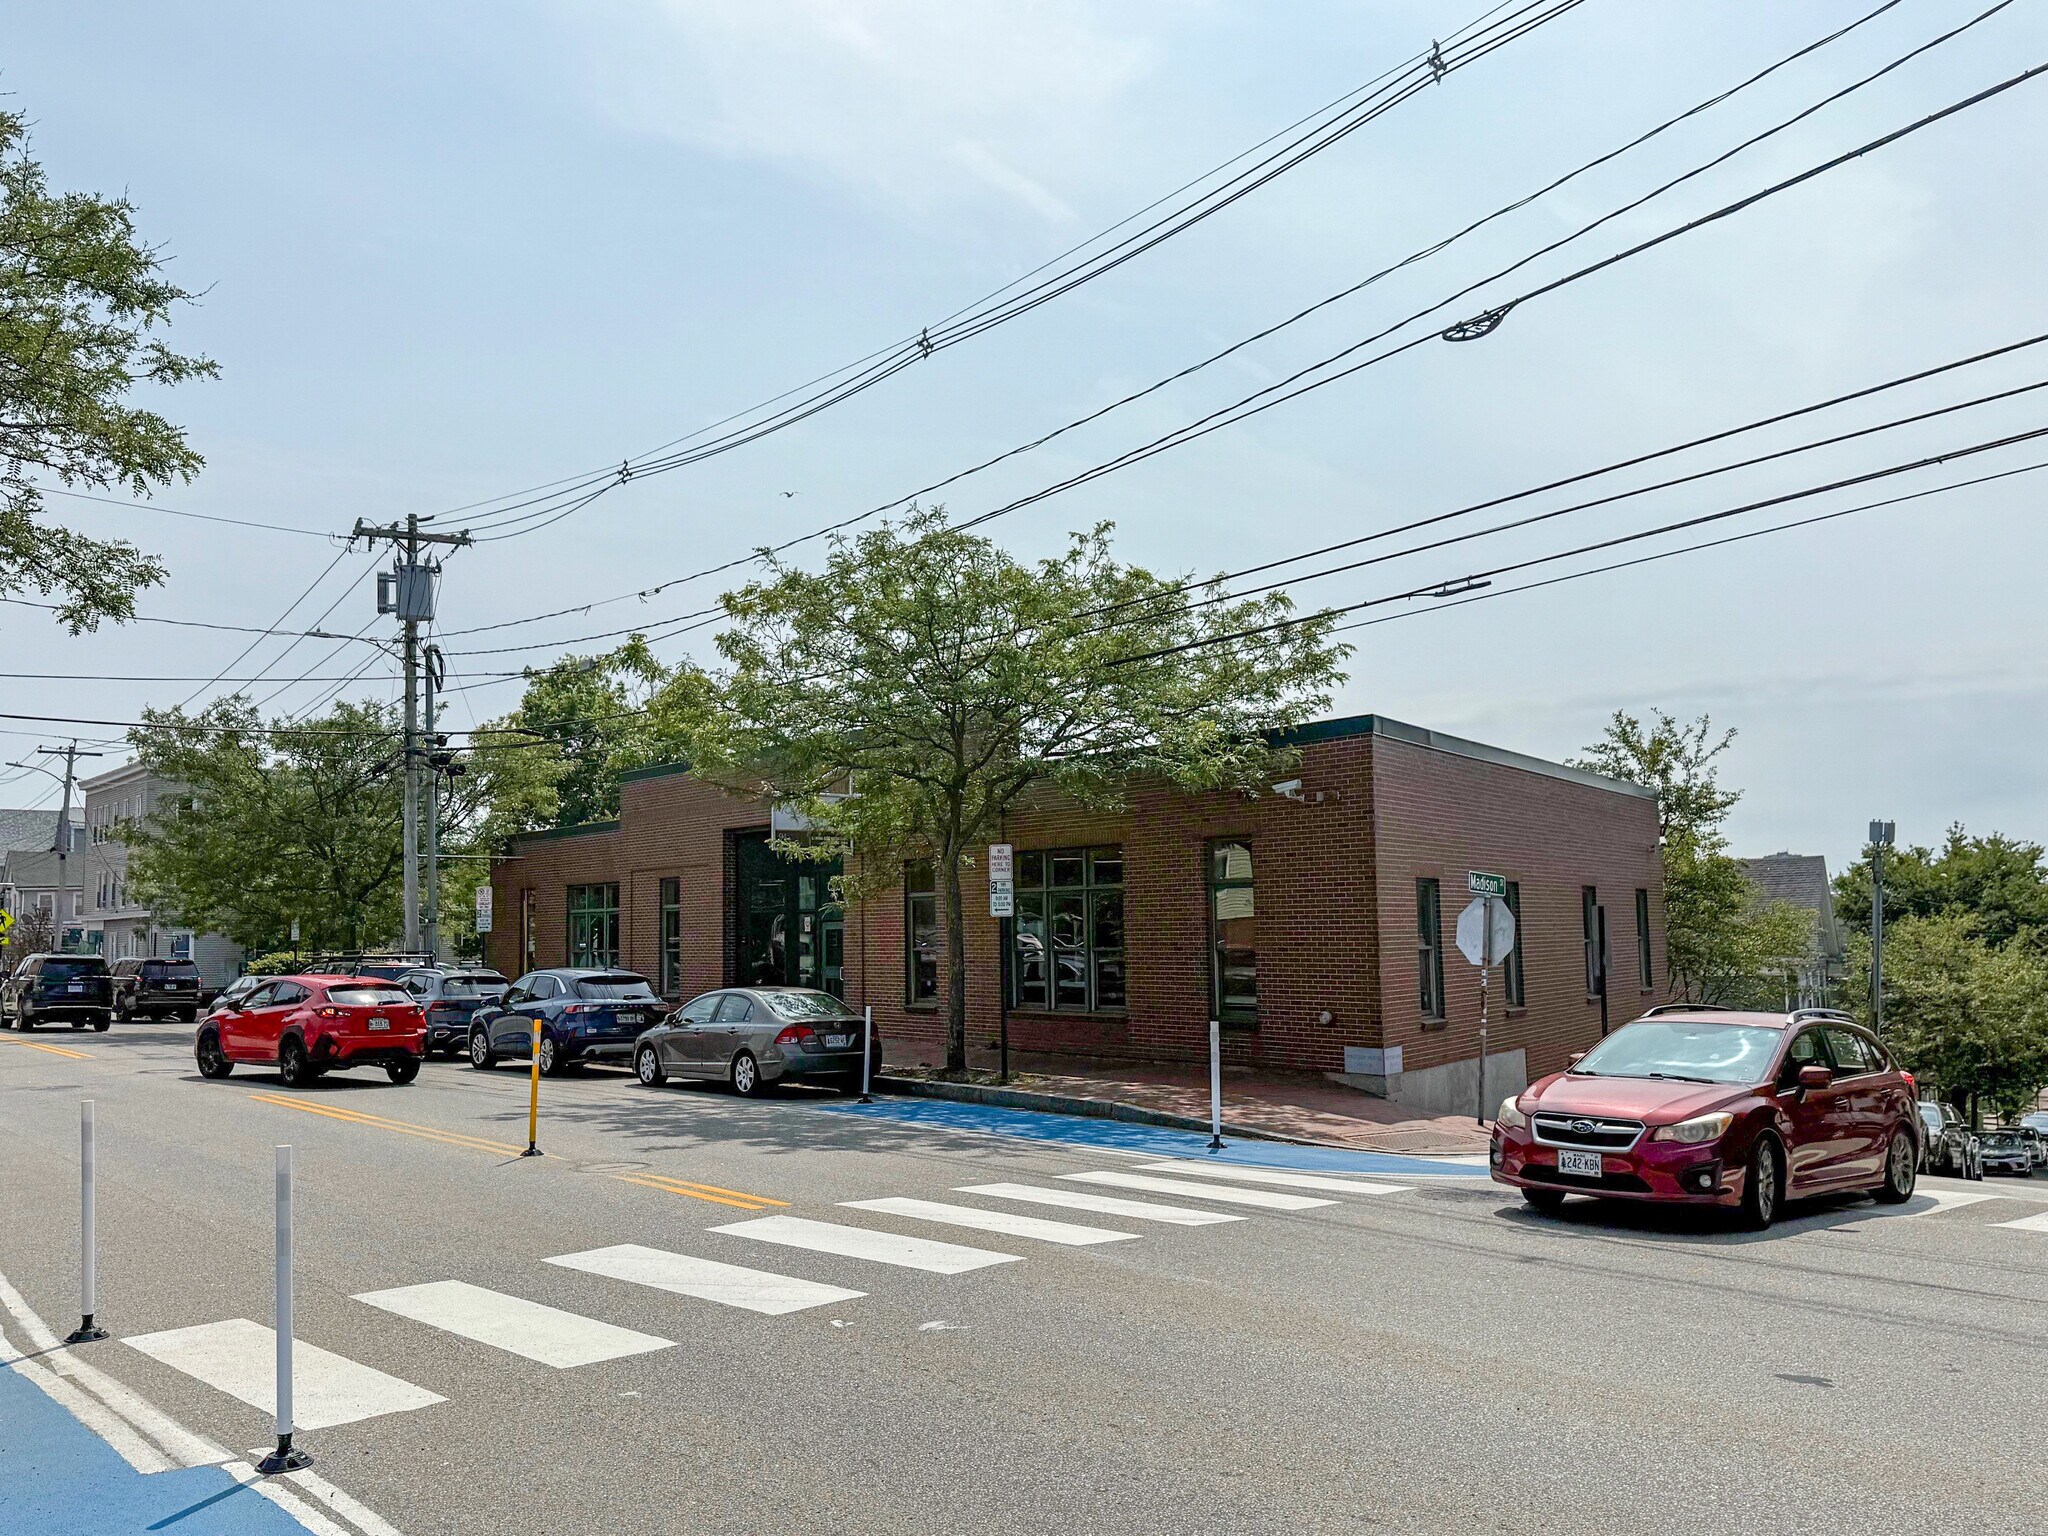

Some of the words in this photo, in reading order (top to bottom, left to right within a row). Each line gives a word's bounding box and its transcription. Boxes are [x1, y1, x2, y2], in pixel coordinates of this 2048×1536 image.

[991, 882, 997, 893] 2
[1470, 874, 1498, 892] Madison
[1567, 1156, 1600, 1170] 242-KBN
